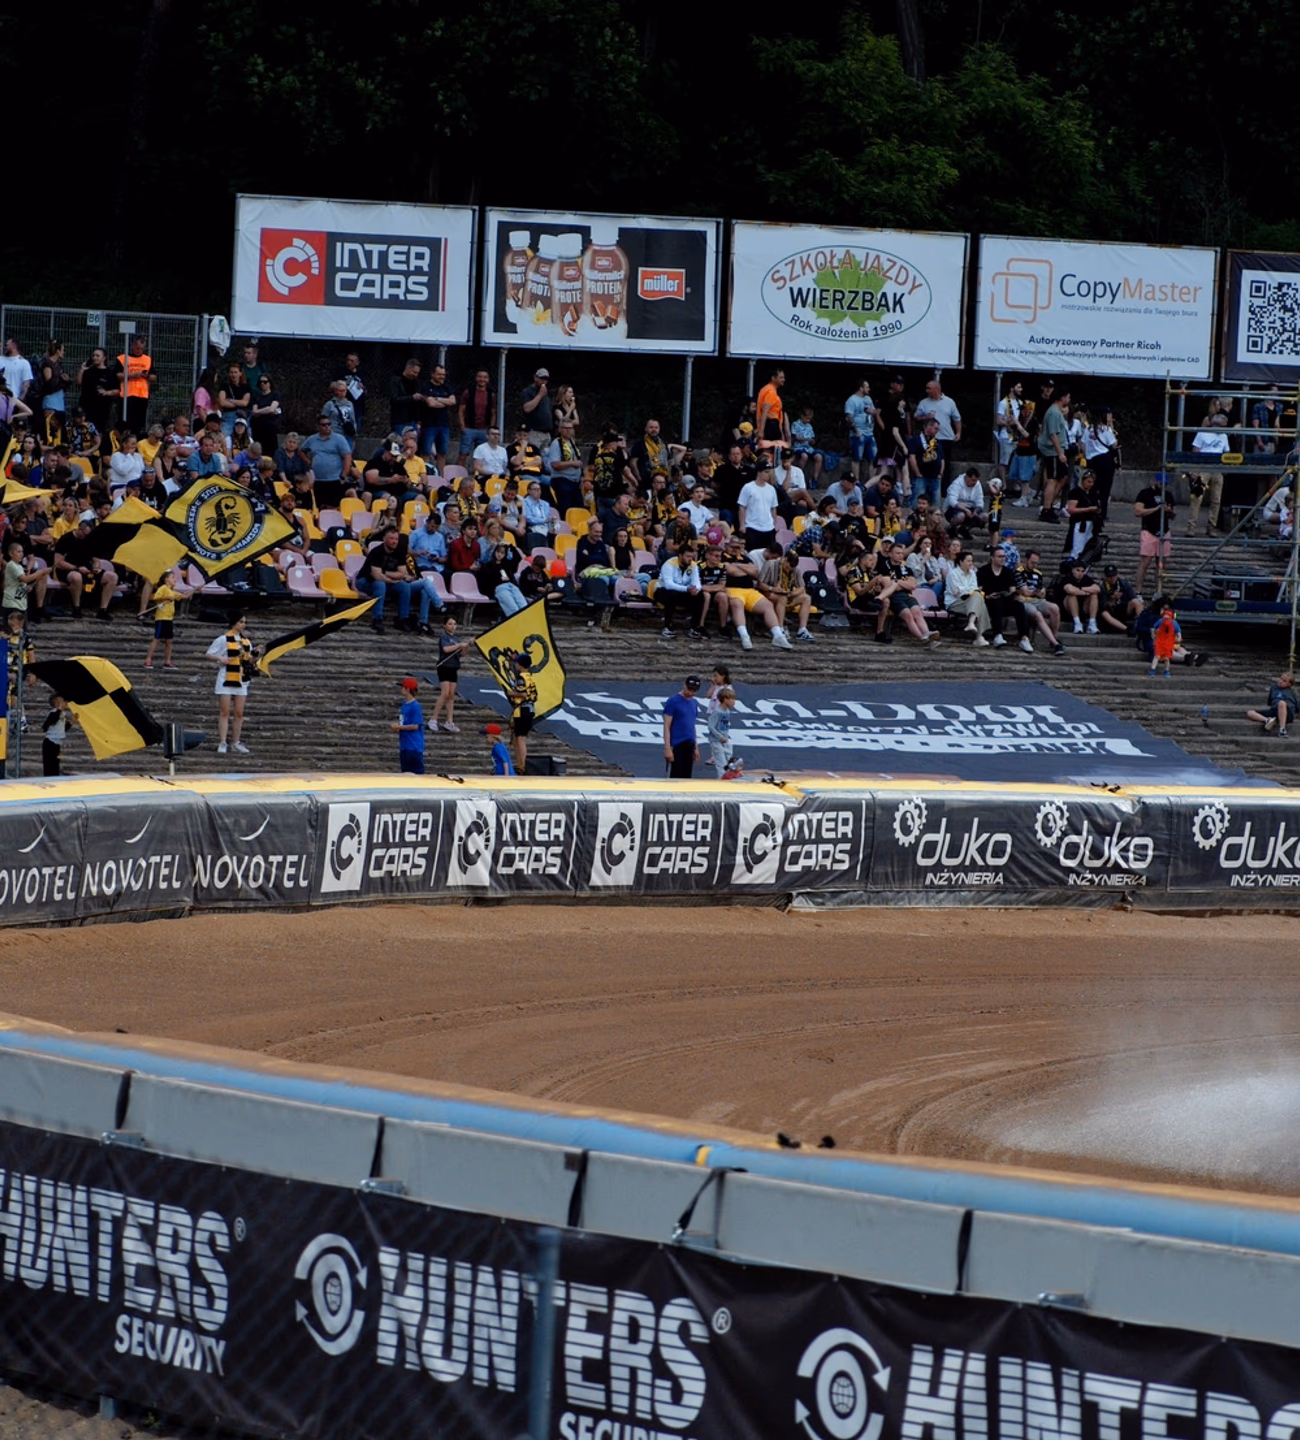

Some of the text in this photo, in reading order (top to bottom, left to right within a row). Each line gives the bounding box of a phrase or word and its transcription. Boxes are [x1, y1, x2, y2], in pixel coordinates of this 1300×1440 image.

[335, 242, 431, 271] INTER
[334, 272, 429, 301] CARS
[643, 274, 680, 292] müller
[770, 249, 924, 296] SZKOŁA JAZDY
[789, 286, 906, 314] WIERZBAK
[1059, 273, 1203, 304] CopyMaster
[1061, 303, 1102, 312] mistrzowskie
[1154, 308, 1181, 317] Twojego
[1182, 309, 1198, 317] biura
[790, 314, 903, 339] Rok założenia 1990
[1028, 335, 1162, 351] Autoryzowany Partner Ricoh
[1187, 356, 1200, 364] CAD
[372, 812, 433, 843] INTER
[499, 812, 567, 842] INTER
[646, 812, 712, 842] INTER
[787, 812, 856, 842] INTER
[916, 817, 1013, 868] duko
[1059, 821, 1154, 870] duko
[192, 853, 309, 889] NOVOTEL
[368, 845, 430, 878] CARS
[498, 844, 563, 875] CARS
[642, 845, 711, 876] CARS
[783, 843, 853, 873] CARS
[81, 854, 182, 897] NOVOTEL
[924, 869, 1005, 887] INŻYNIERIA
[1067, 870, 1148, 888] INŻYNIERIA
[114, 1313, 226, 1376] SECURITY
